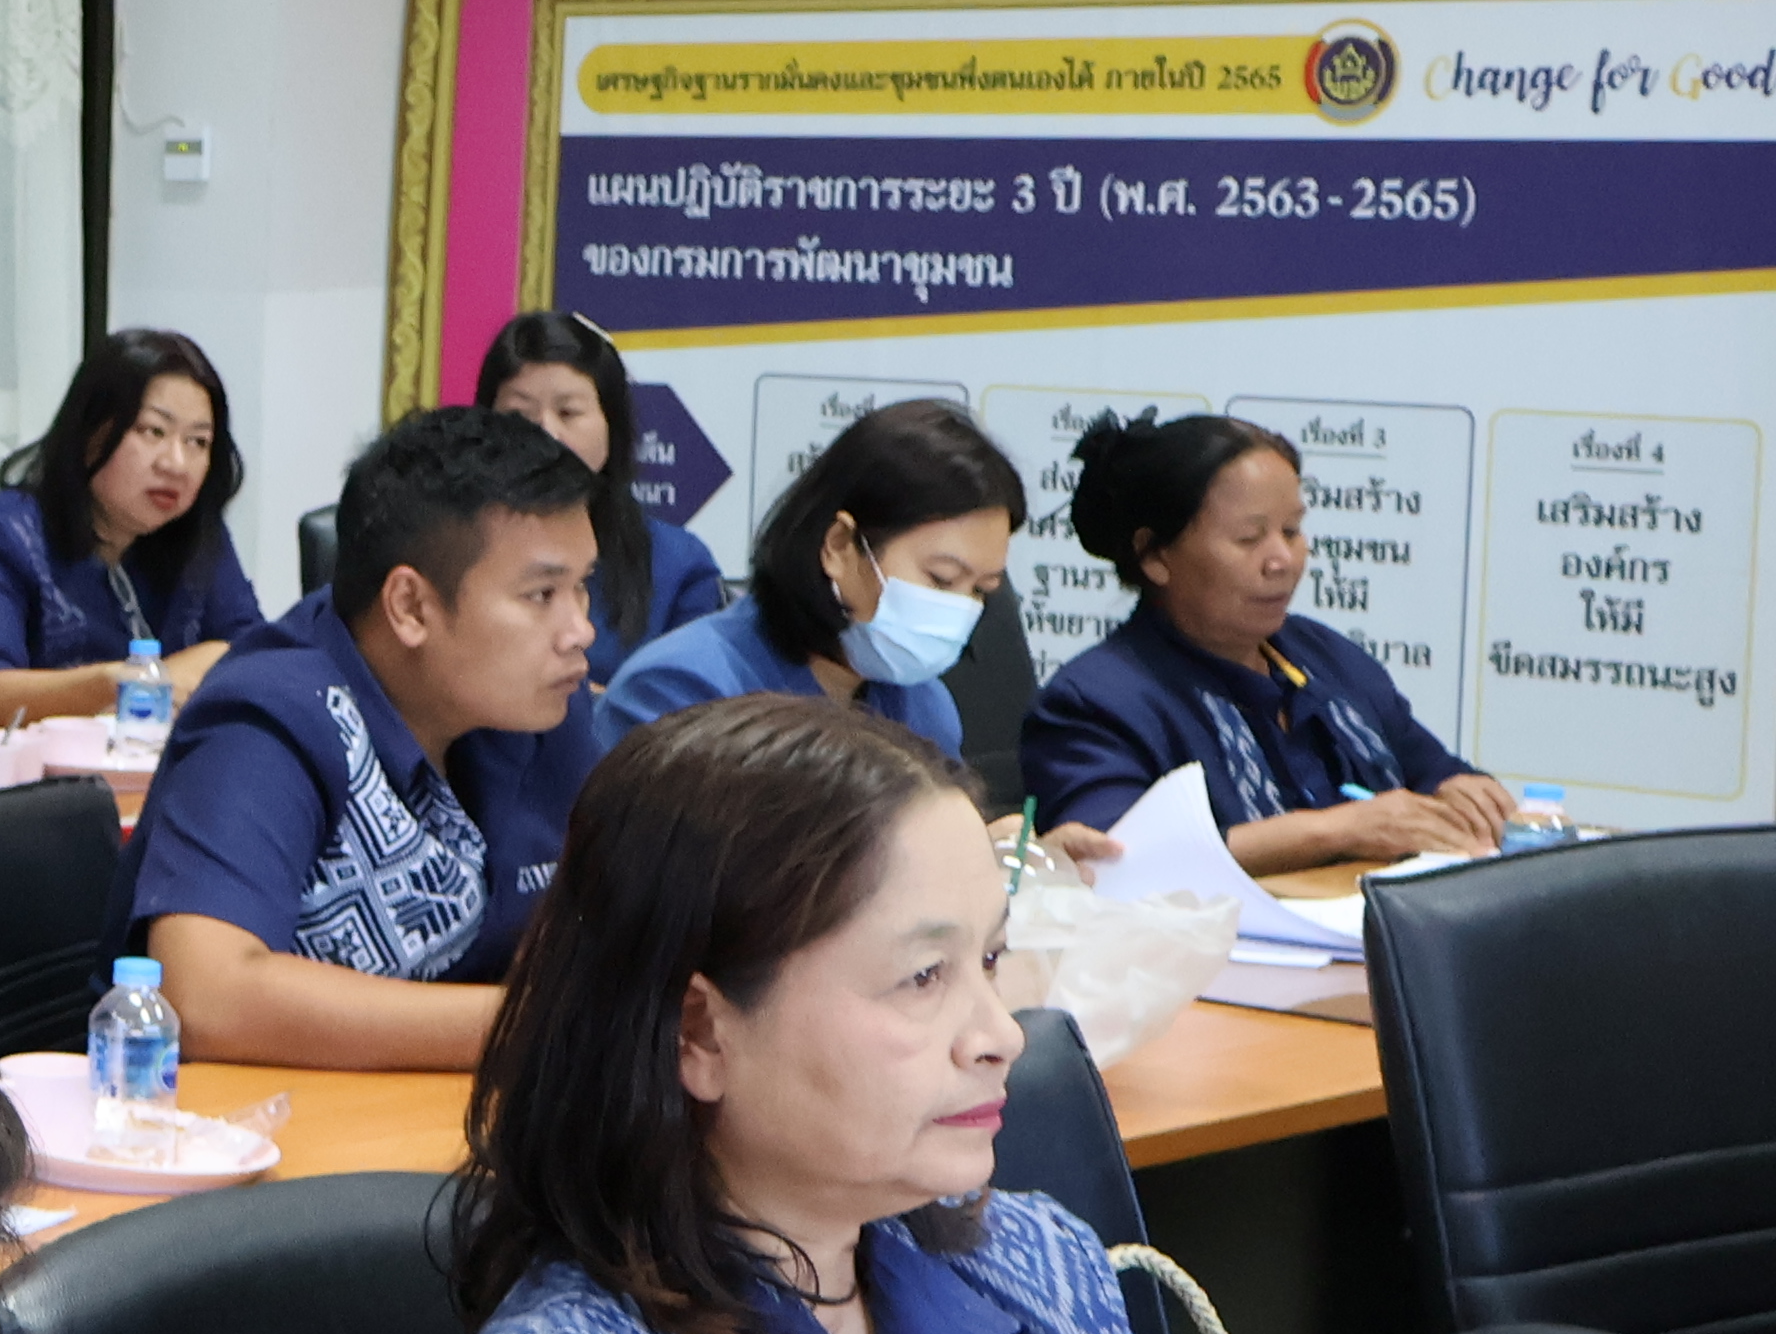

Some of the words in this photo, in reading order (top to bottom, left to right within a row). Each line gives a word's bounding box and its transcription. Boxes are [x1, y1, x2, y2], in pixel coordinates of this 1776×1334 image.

[1216, 64, 1283, 92] 2565
[1423, 50, 1582, 113] Change
[1591, 48, 1659, 115] for
[1669, 47, 1776, 101] Good
[587, 162, 995, 220] แผนปฏิบัติราชการระยะ
[1011, 174, 1036, 213] 3
[1049, 163, 1083, 214] ปี
[1099, 172, 1197, 223] (พ.ศ.
[582, 235, 1014, 303] ของกรมการพัฒนาชุมชน
[1375, 427, 1387, 449] 3
[1651, 442, 1665, 464] 4
[1302, 475, 1422, 515] ริมสร้าง
[1538, 492, 1702, 535] เสริมสร้าง
[1561, 543, 1671, 584] องค์กร
[1488, 639, 1737, 708] ขีดสมรรถนะสูง
